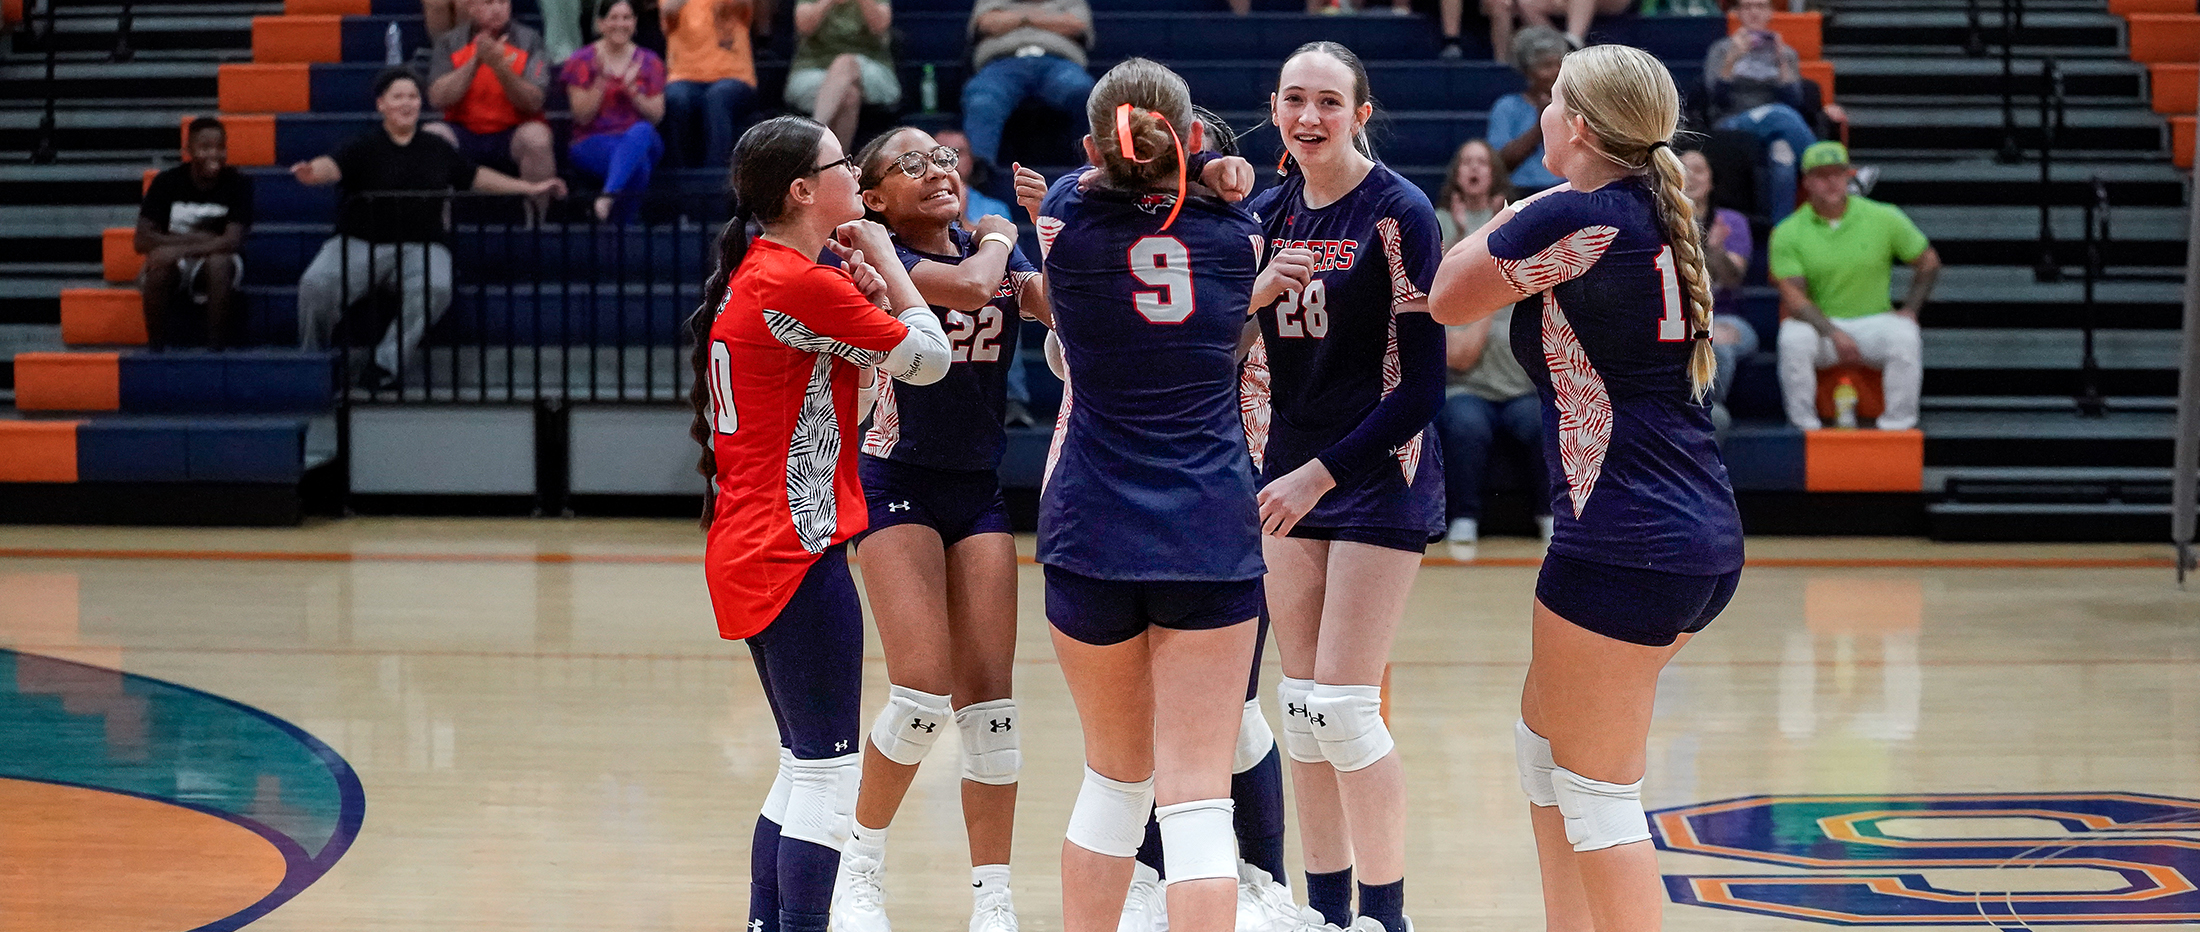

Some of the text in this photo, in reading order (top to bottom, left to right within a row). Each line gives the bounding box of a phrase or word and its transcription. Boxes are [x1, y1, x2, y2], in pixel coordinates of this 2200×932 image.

[1127, 234, 1196, 324] 9
[1268, 238, 1359, 272] TERS
[1275, 278, 1329, 339] 28
[1653, 244, 1713, 342] 1
[945, 305, 1003, 363] 22
